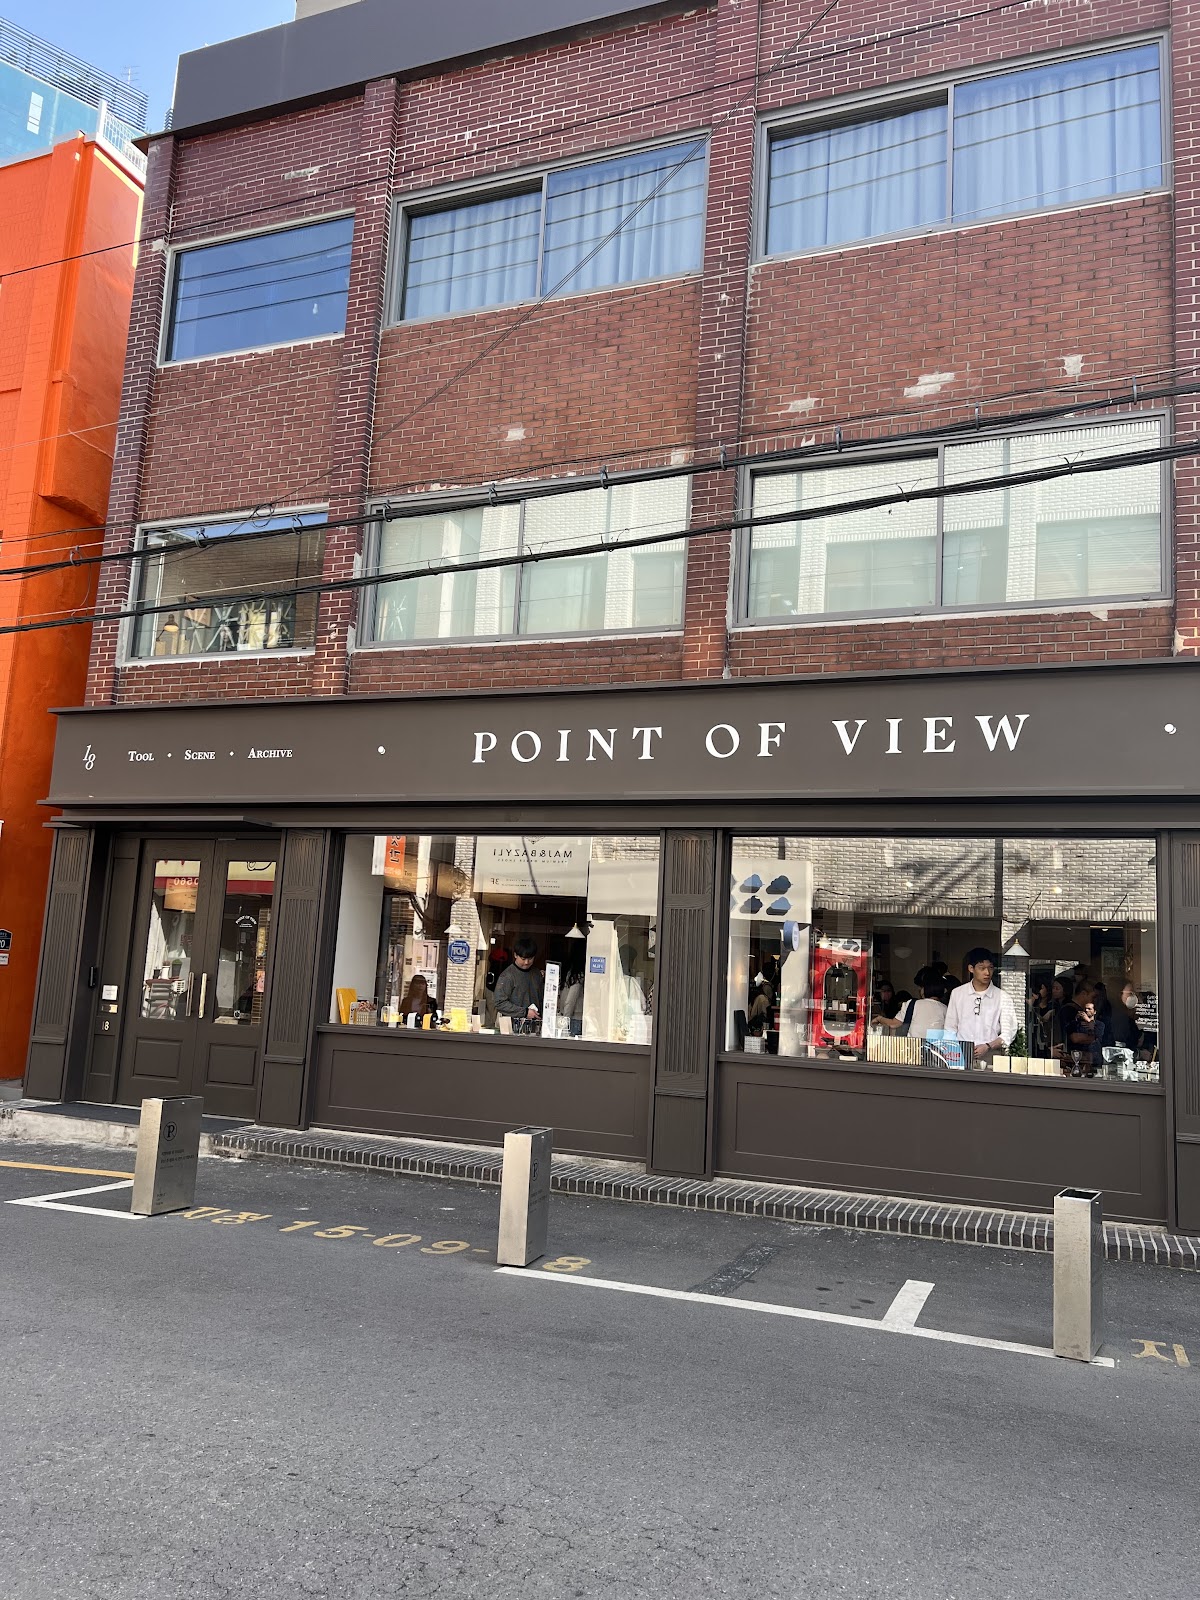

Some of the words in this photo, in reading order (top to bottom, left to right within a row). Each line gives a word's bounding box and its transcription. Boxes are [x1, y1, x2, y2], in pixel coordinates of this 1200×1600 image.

[472, 726, 663, 764] POINT
[705, 722, 786, 760] OF
[832, 713, 1031, 756] VIEW
